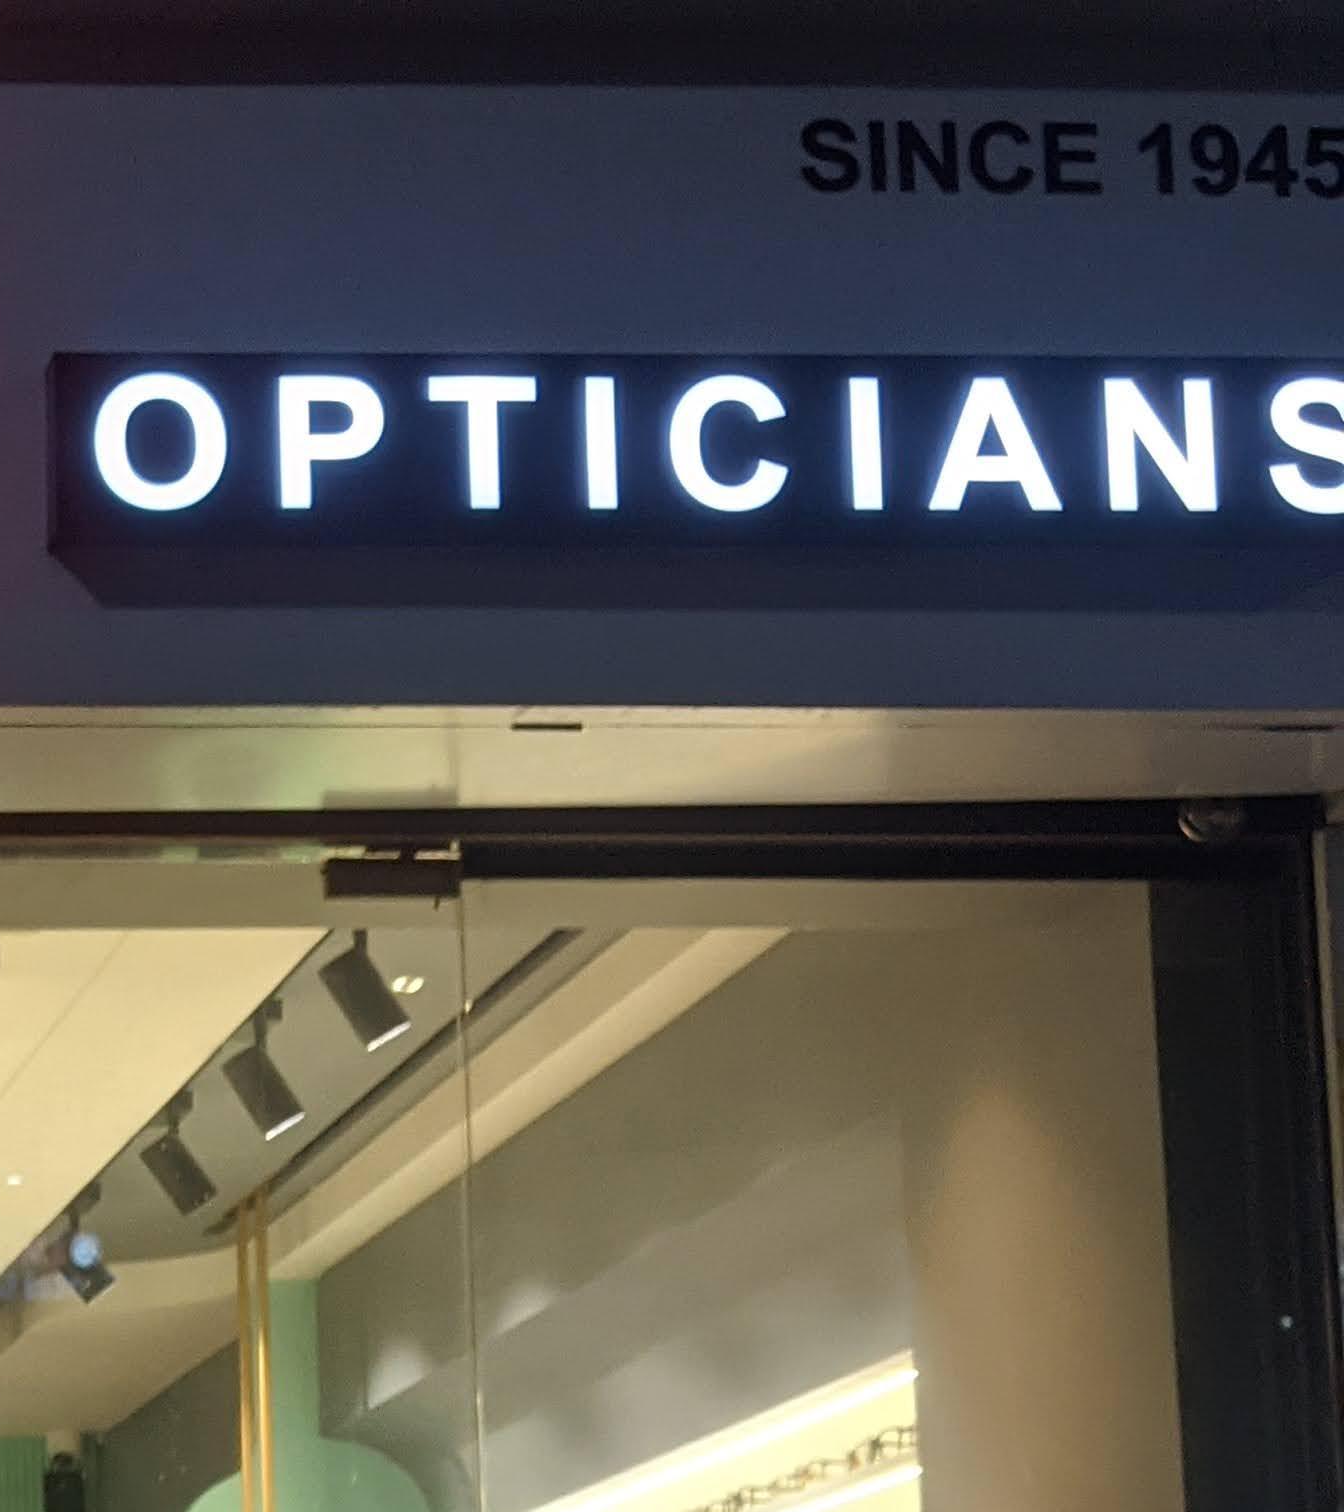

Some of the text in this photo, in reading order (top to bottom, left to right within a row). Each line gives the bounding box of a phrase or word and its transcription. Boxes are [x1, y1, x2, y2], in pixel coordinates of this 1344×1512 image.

[800, 118, 1344, 200] SINCE 1945
[92, 372, 1344, 515] OPTICIANS
